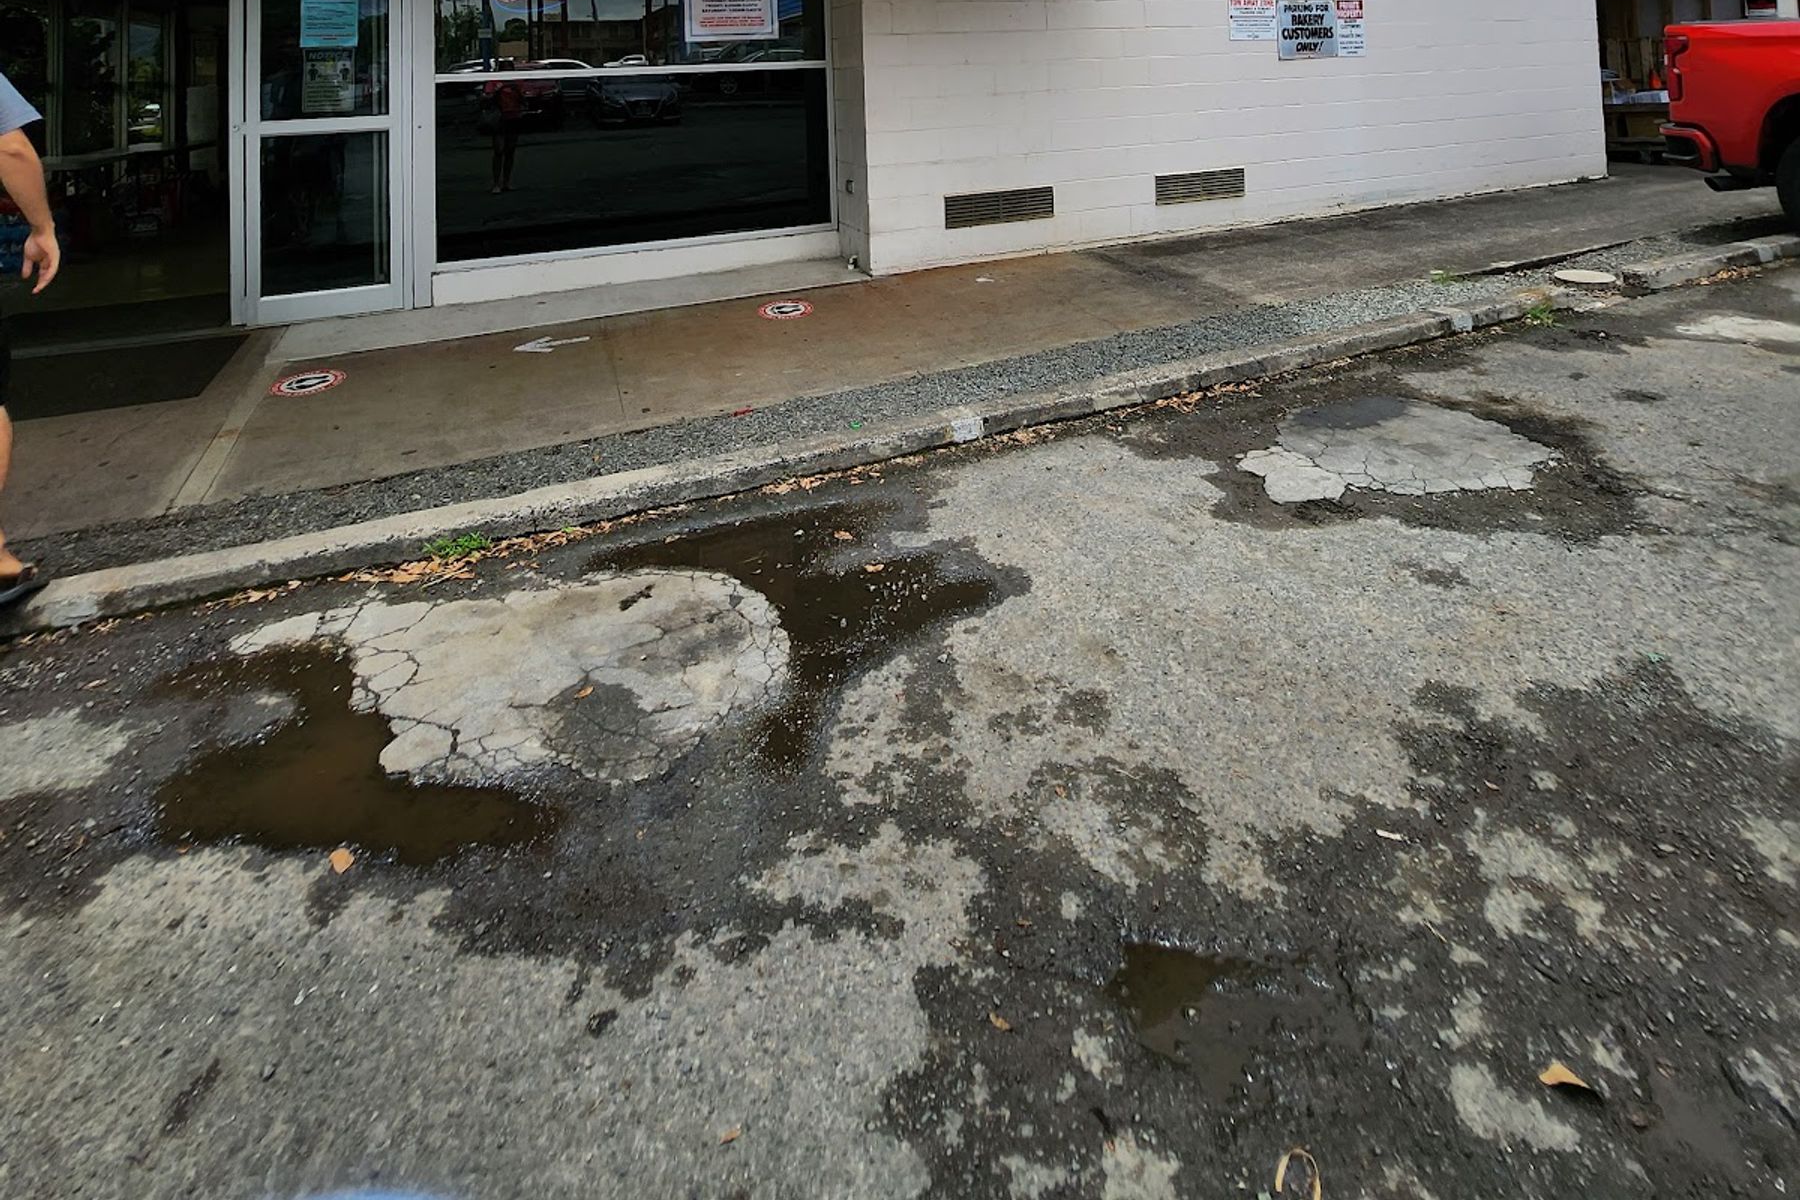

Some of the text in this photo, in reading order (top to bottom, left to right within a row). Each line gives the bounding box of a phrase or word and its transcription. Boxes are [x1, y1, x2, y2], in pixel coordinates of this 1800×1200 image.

[1283, 4, 1313, 13] PARKING
[1315, 4, 1329, 12] FOR
[1291, 13, 1325, 27] BAKERY
[1281, 26, 1334, 41] CUSTOMERS
[1295, 41, 1324, 54] ONLY!
